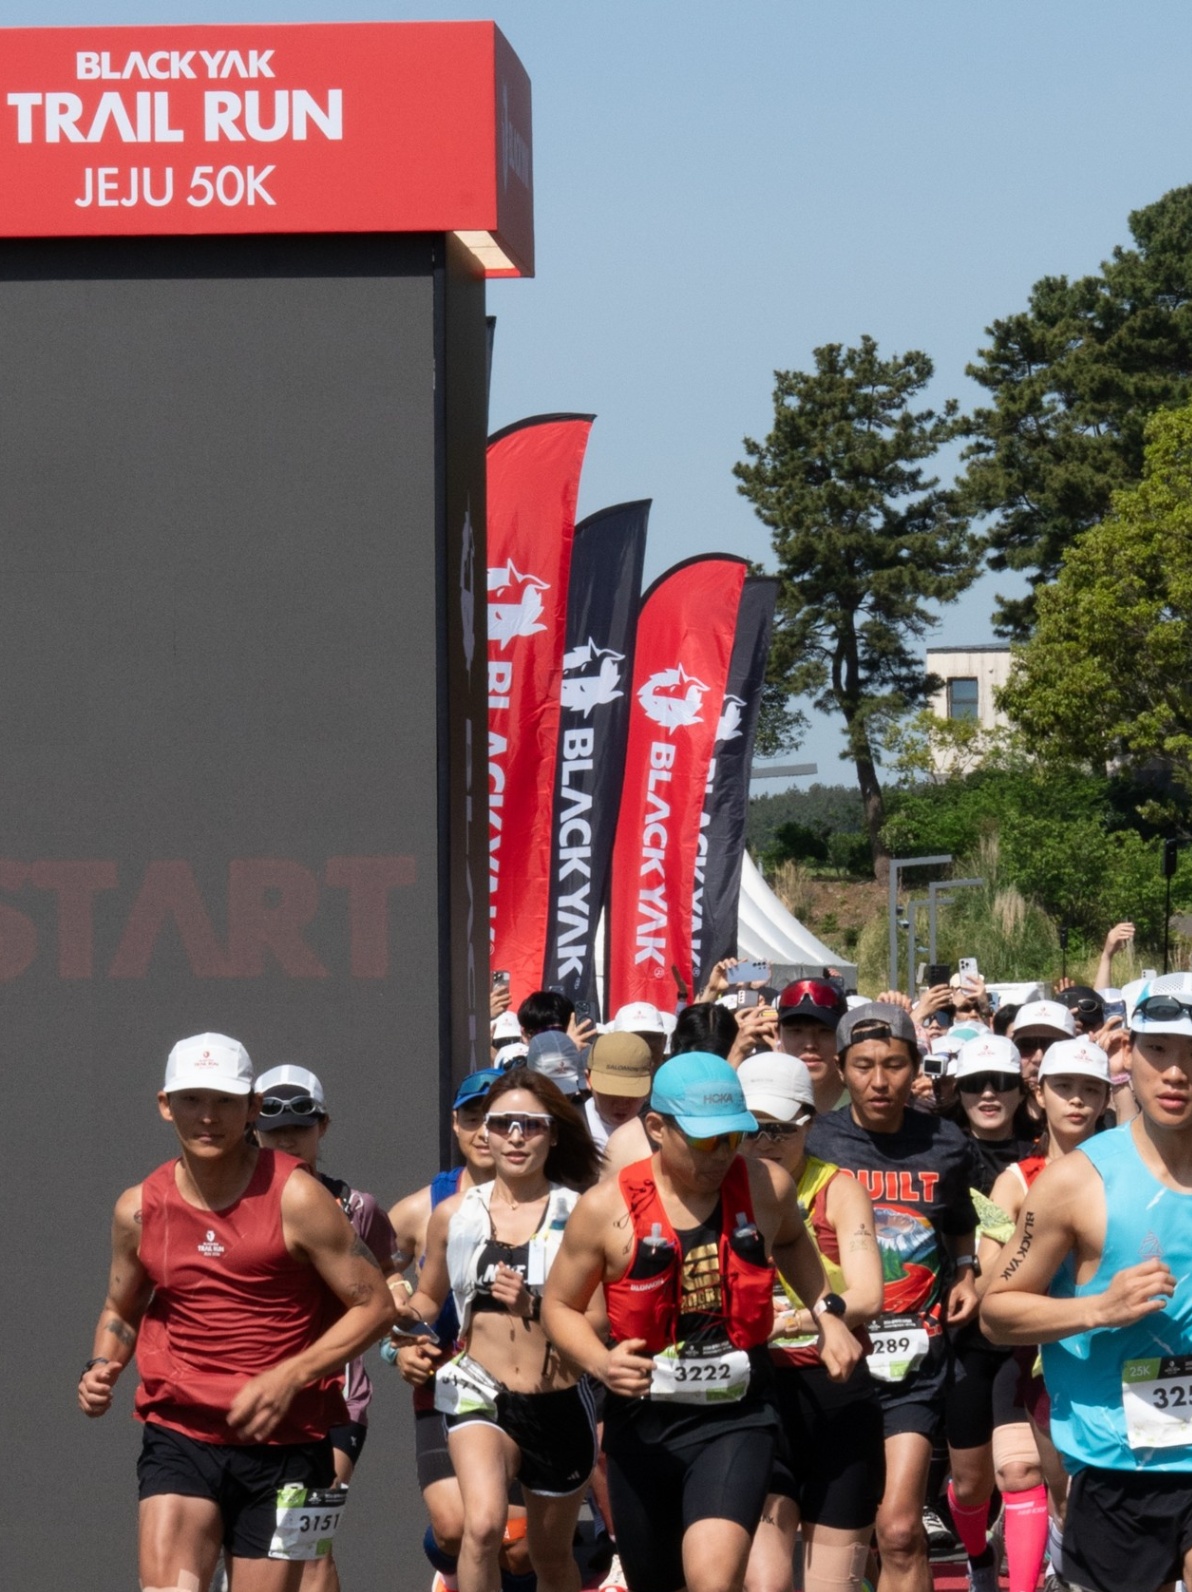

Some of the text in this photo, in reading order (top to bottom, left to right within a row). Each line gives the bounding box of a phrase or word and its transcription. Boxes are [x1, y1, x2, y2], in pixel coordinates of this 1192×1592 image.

[77, 50, 276, 80] BLACKYAK
[8, 89, 343, 144] TRAIL RUN
[75, 165, 277, 208] JEJU 50K
[557, 728, 593, 979] BLACKYAK
[635, 741, 675, 967] BLACKYAK
[703, 1093, 734, 1104] HOKA
[840, 1168, 939, 1202] UILT
[674, 1364, 731, 1382] 3222
[1130, 1366, 1150, 1377] 25K
[300, 1514, 338, 1533] 3151
